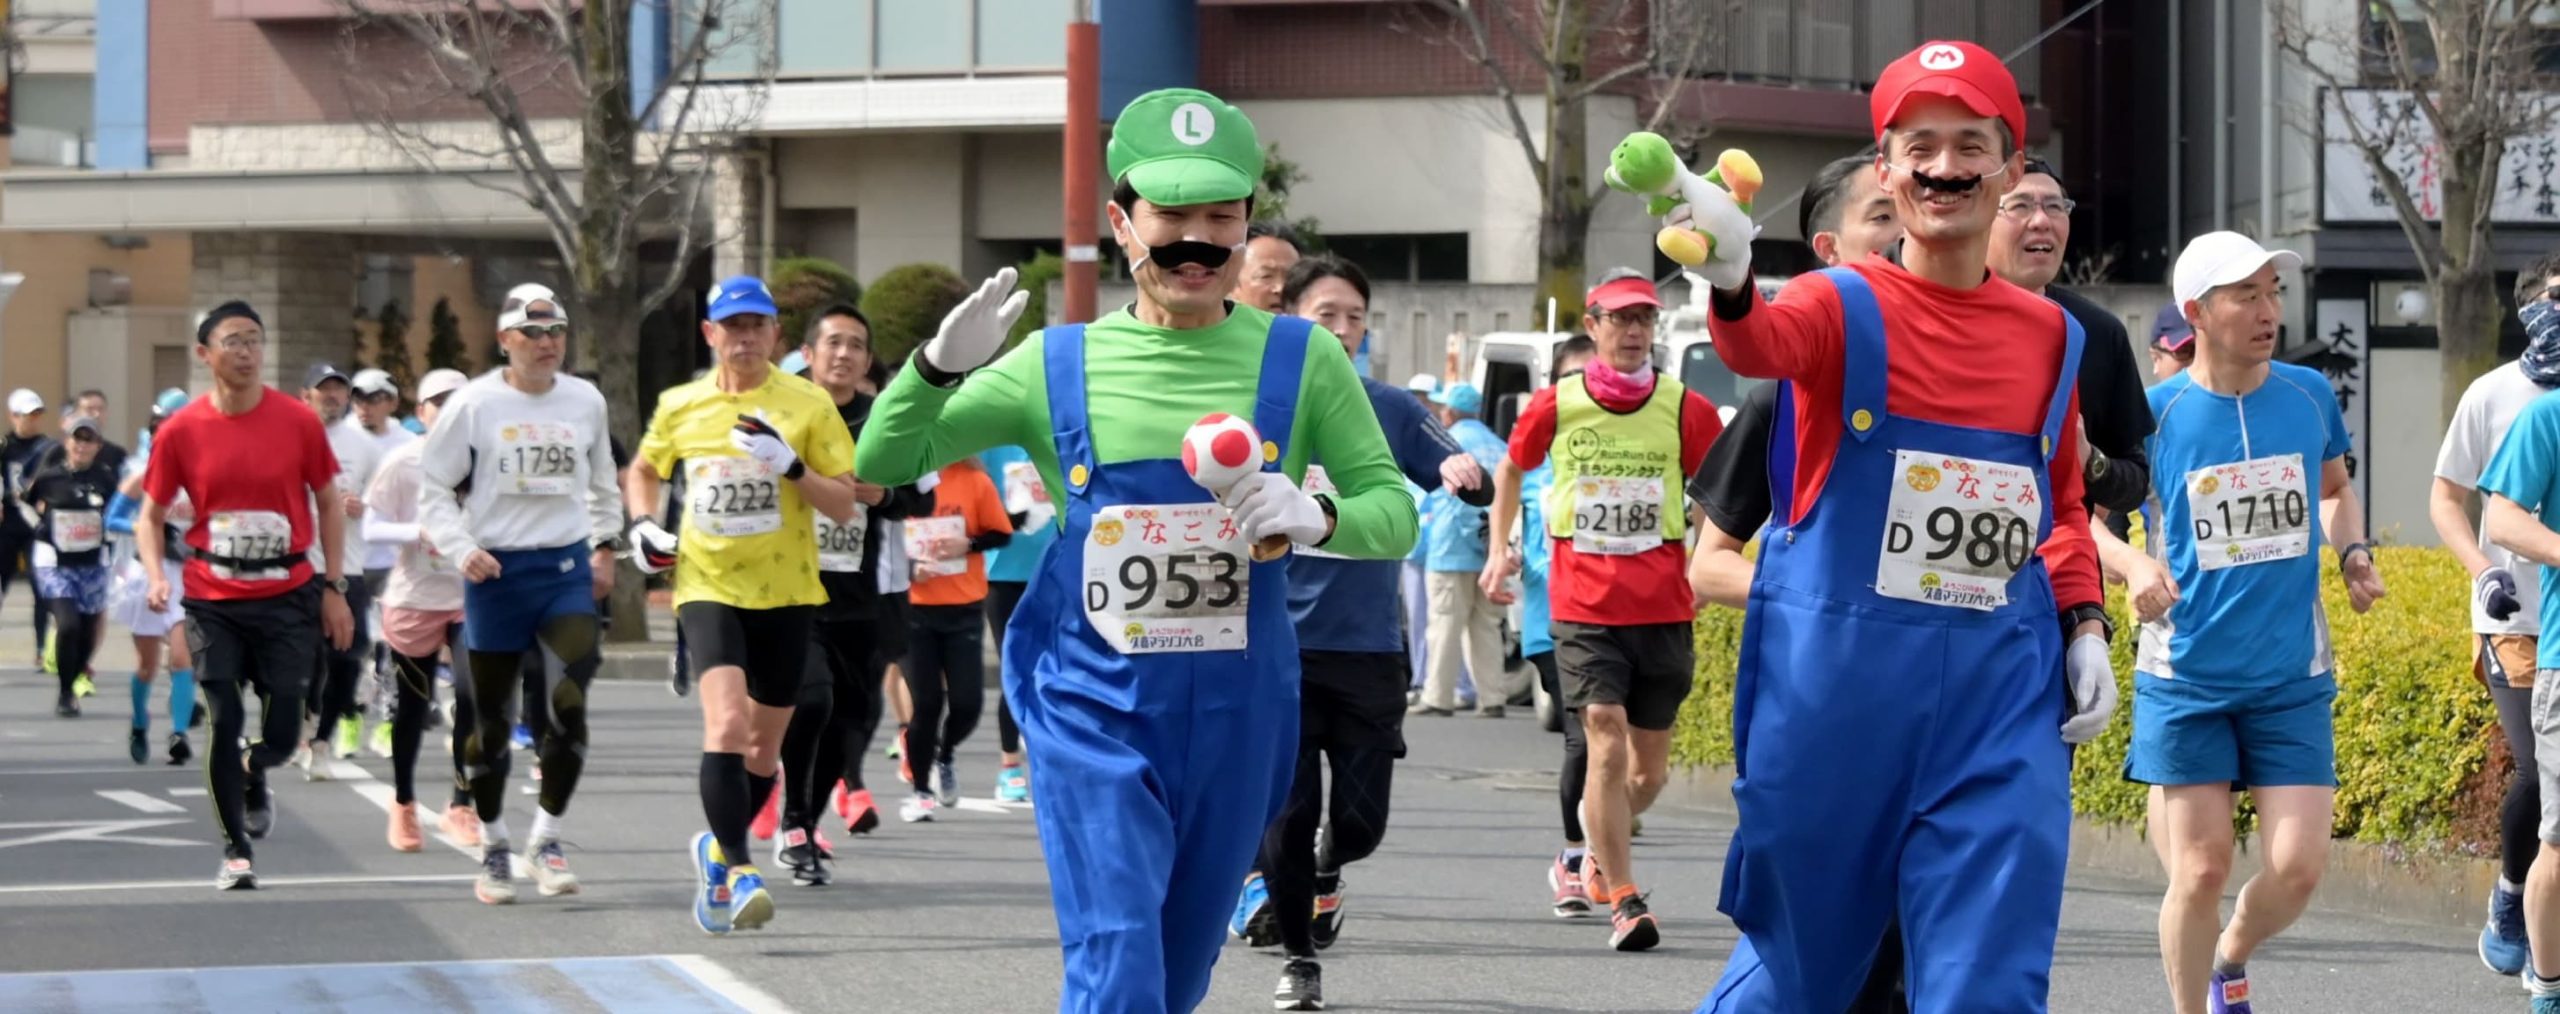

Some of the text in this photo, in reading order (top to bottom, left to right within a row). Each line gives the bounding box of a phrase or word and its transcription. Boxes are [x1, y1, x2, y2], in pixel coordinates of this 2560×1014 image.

[1928, 50, 1956, 64] M
[1185, 111, 1201, 137] L
[500, 446, 575, 473] E 1795
[1600, 450, 1669, 461] RunRun Club
[695, 481, 776, 514] E 2222
[1576, 503, 1660, 532] D 2185
[2195, 489, 2304, 541] D 1710
[228, 535, 285, 561] 1774
[1887, 506, 2030, 572] D 980
[1087, 552, 1240, 612] D 953
